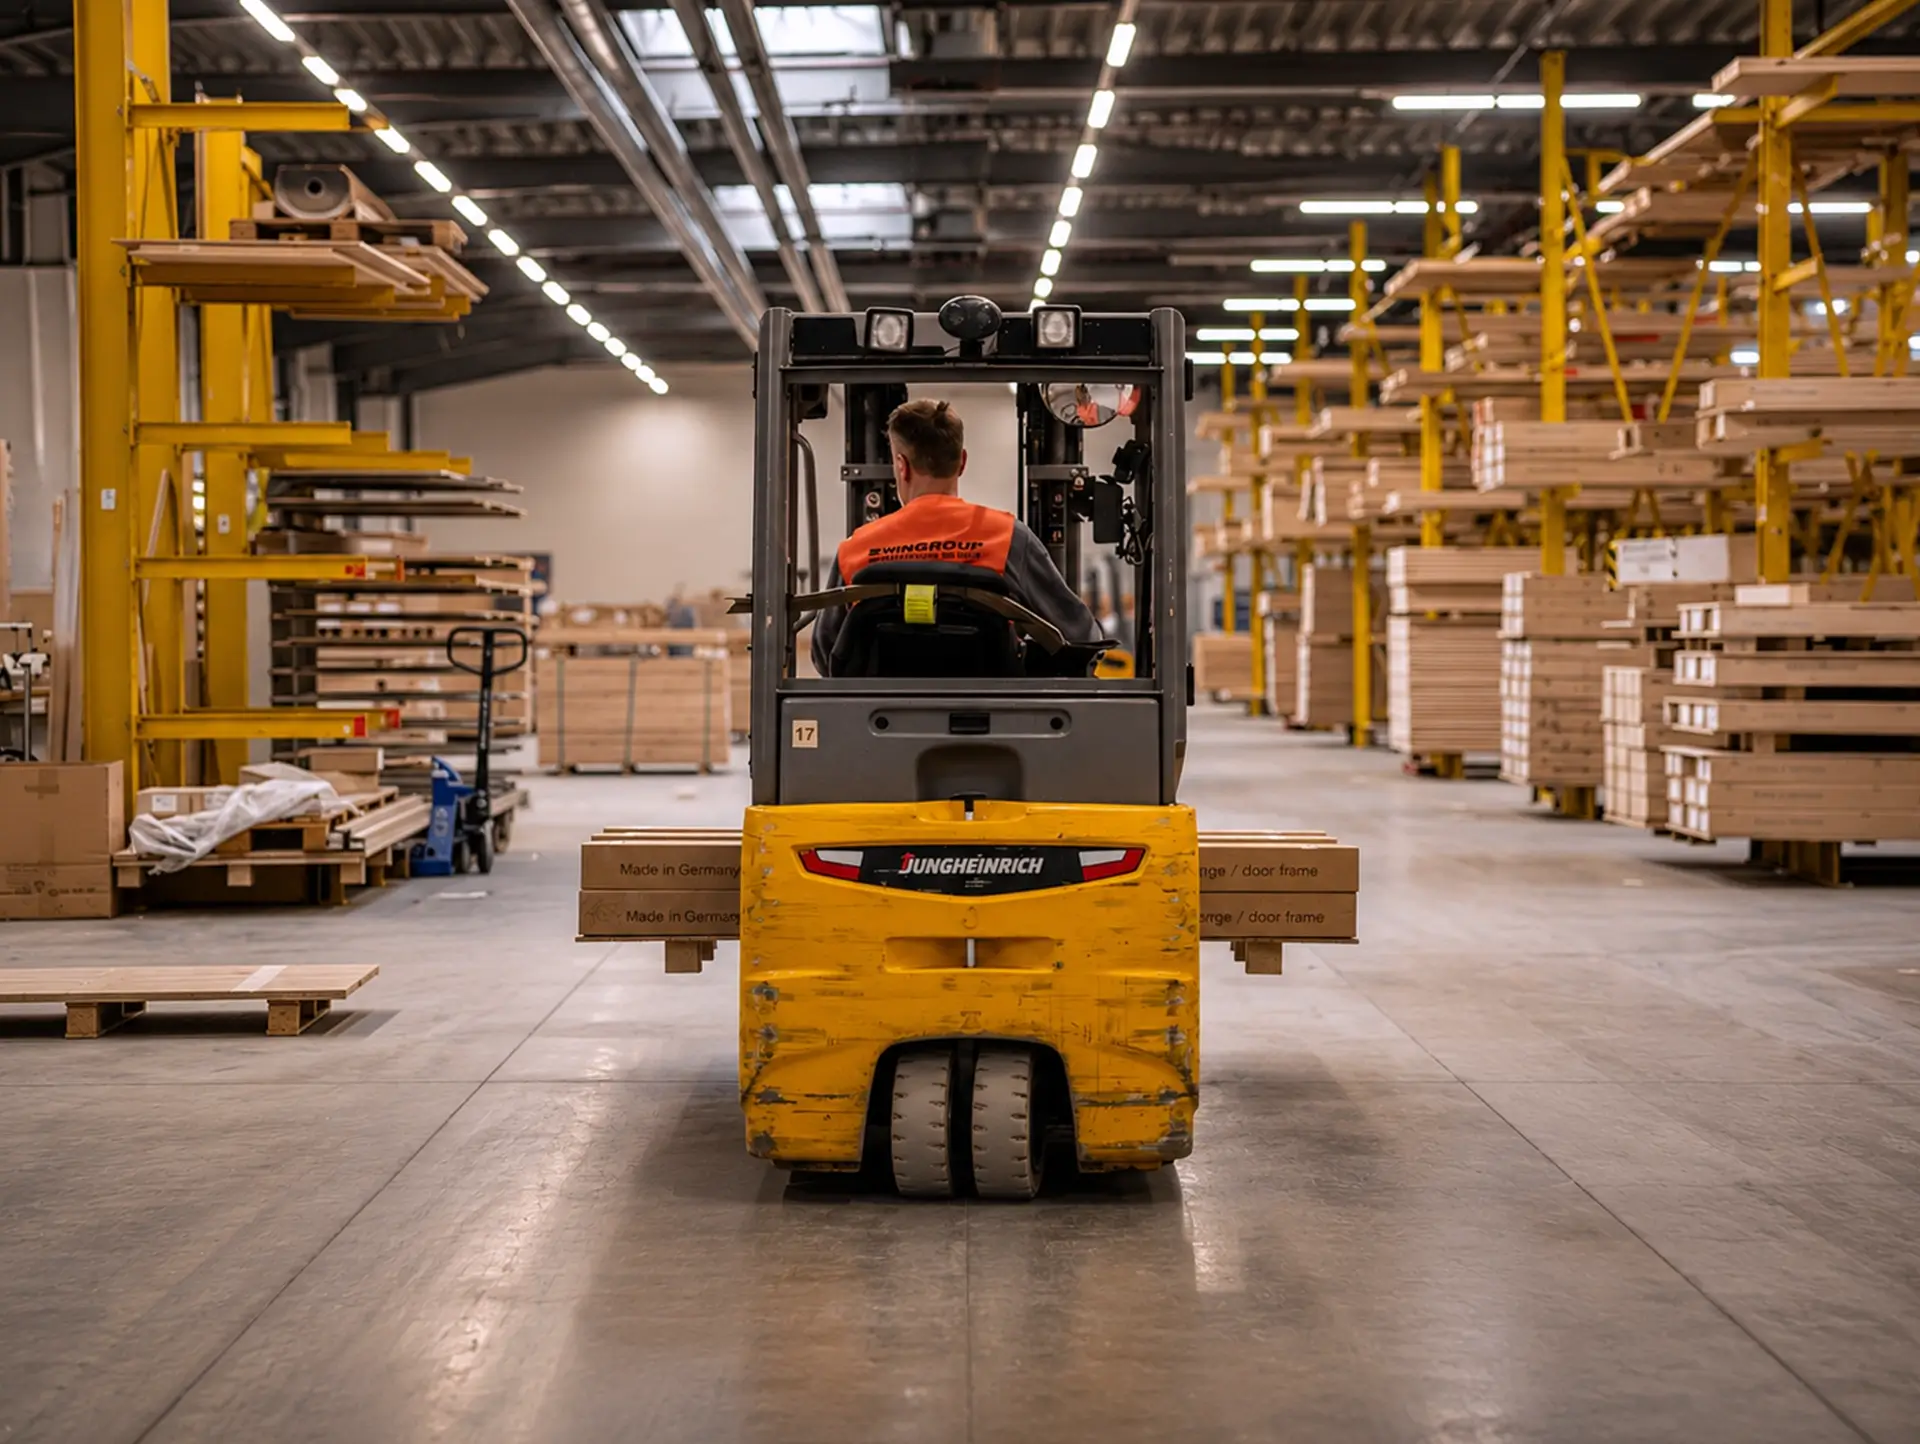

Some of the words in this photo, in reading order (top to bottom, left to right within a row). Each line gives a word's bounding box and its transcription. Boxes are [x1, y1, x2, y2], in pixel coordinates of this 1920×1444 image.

[795, 727, 815, 741] 17
[899, 853, 1044, 874] JUNGHEINRICH
[1242, 865, 1275, 877] door
[1280, 863, 1318, 877] frame
[620, 864, 658, 875] Made
[663, 864, 675, 875] in
[679, 864, 740, 878] Germany
[626, 911, 664, 922] Made
[669, 910, 681, 922] in
[1248, 911, 1281, 923] door
[1286, 911, 1324, 924] frame
